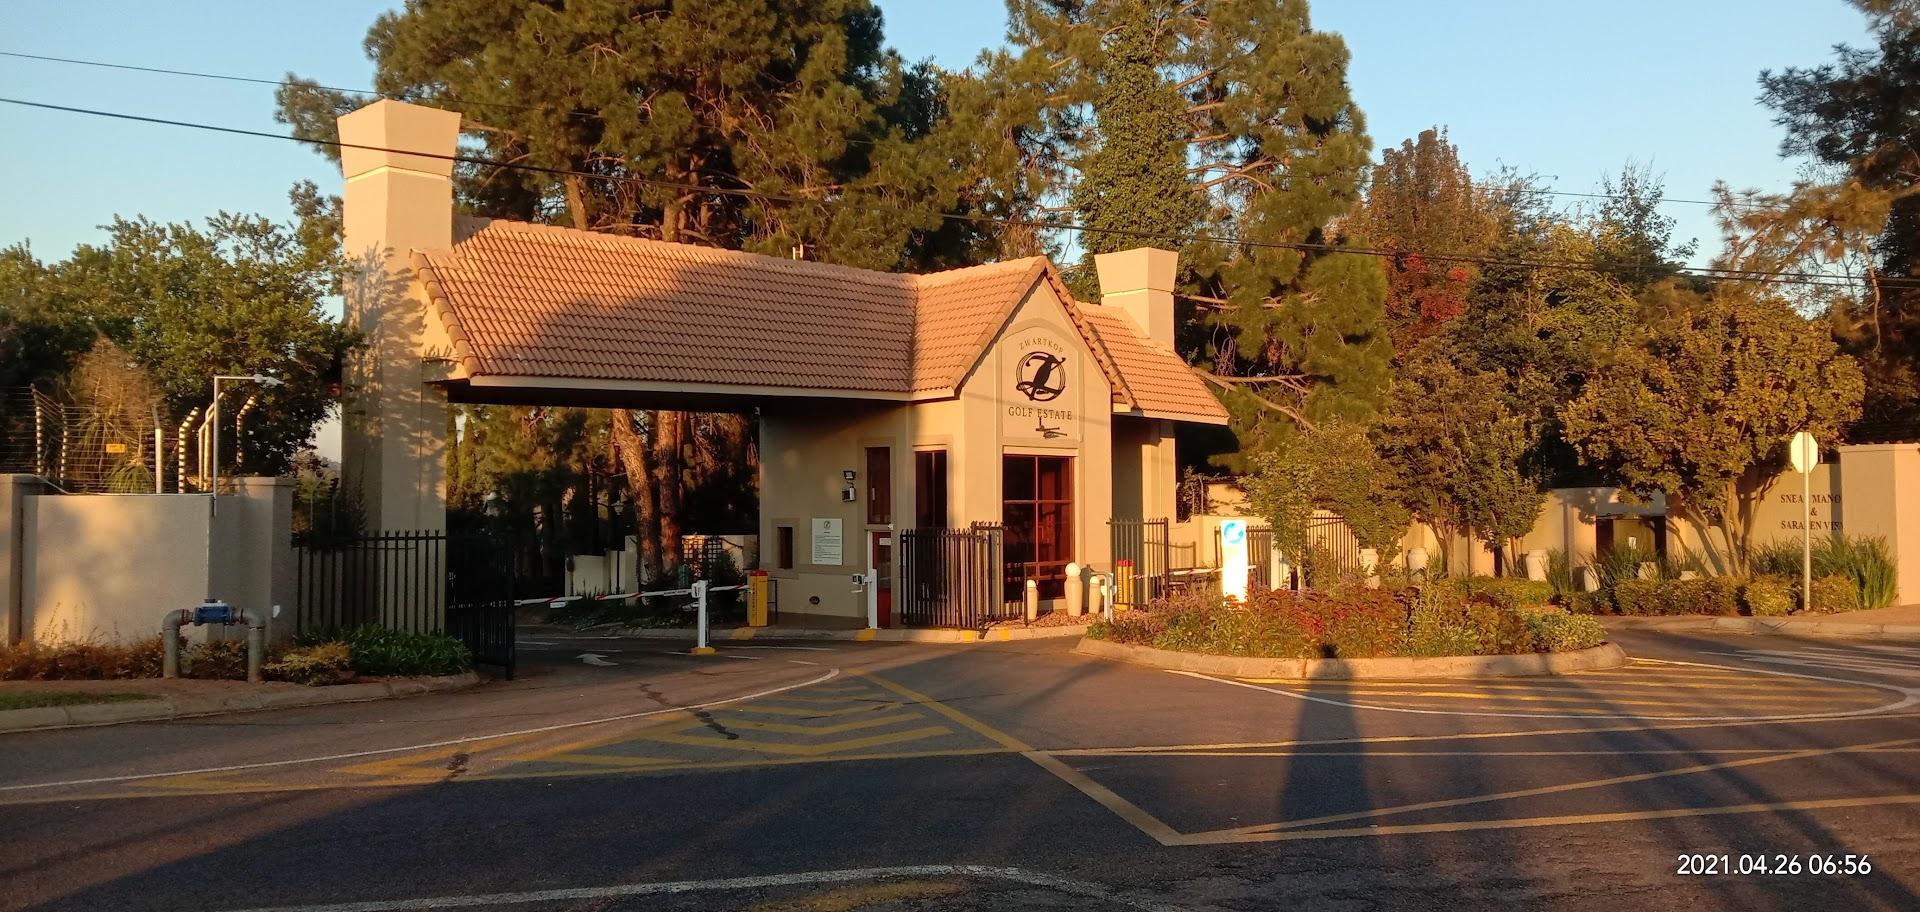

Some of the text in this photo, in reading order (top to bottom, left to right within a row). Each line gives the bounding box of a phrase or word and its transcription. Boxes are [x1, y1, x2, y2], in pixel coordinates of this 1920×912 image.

[1019, 338, 1063, 353] ZWARTKOP
[1008, 406, 1073, 420] GOLF ESTATE
[1780, 494, 1808, 504] SNEA
[1810, 507, 1817, 516] &
[1781, 521, 1822, 531] SARAEN
